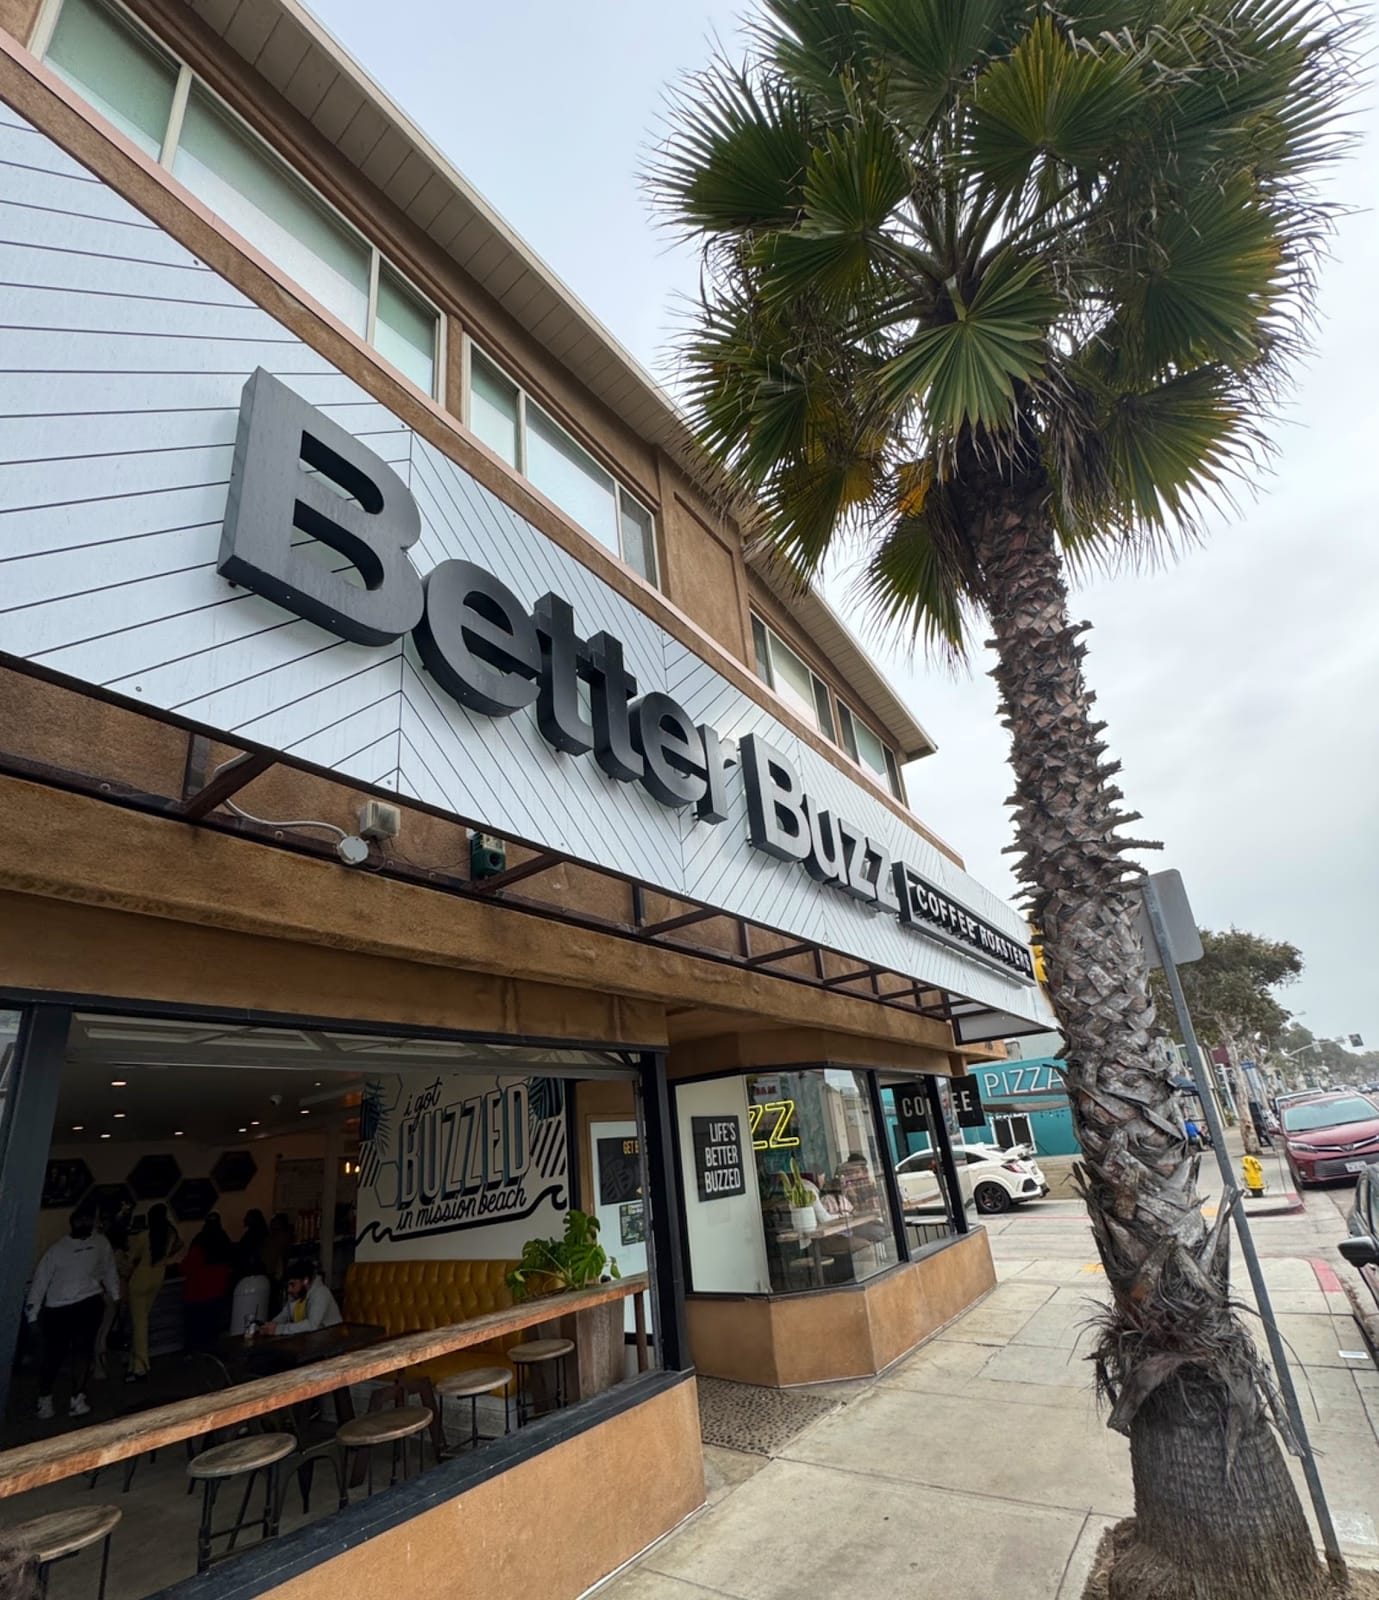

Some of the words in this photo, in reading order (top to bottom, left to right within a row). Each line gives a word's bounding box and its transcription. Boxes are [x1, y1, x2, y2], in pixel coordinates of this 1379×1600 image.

[217, 365, 738, 825] Better
[739, 733, 900, 915] Buzz
[916, 884, 977, 938] COFFEE
[979, 927, 1032, 972] ROASTERS
[409, 1076, 443, 1135] got
[983, 1066, 1066, 1097] PIZZA
[399, 1082, 531, 1210] BUZZED
[705, 1144, 738, 1168] BETTER
[709, 1122, 737, 1143] LIFE'S
[397, 1205, 412, 1230] in
[416, 1192, 477, 1227] mission
[478, 1180, 527, 1215] beach
[704, 1168, 741, 1194] BUZZED
